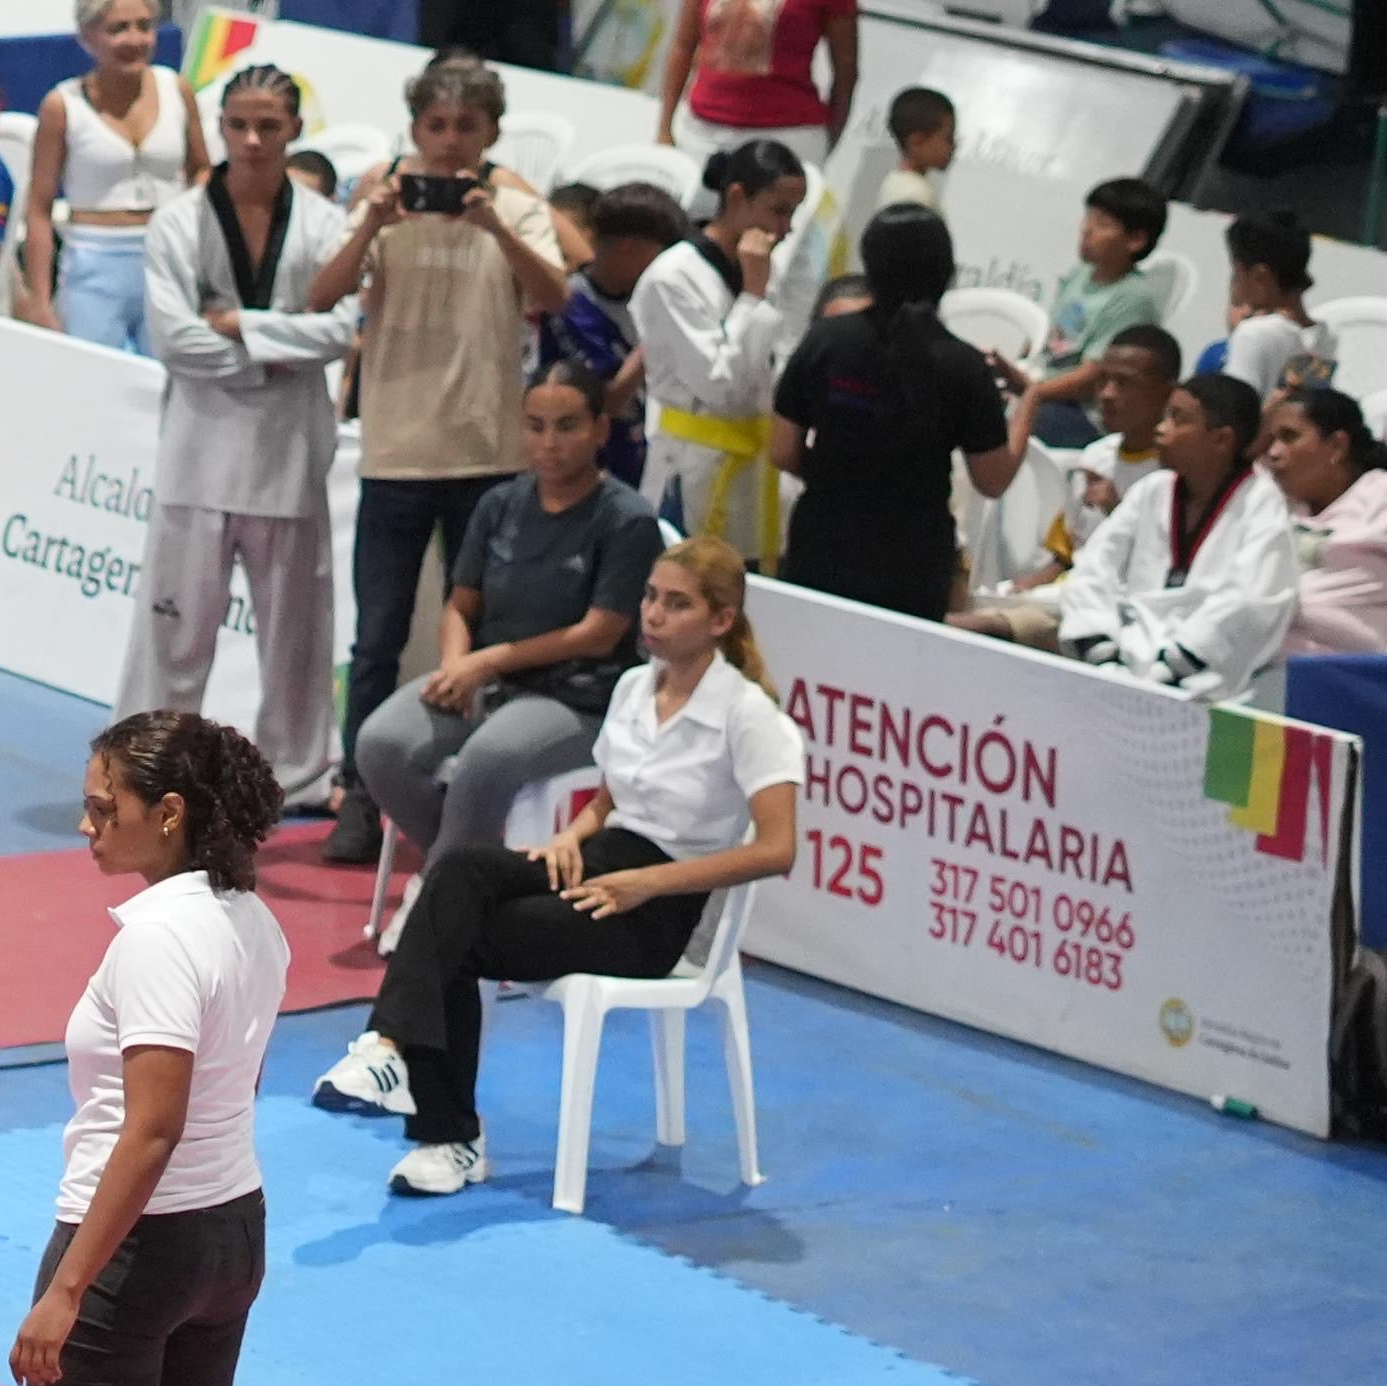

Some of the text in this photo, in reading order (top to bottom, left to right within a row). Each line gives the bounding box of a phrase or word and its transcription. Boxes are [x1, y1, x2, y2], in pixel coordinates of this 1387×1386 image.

[53, 454, 154, 523] Alcal
[1, 512, 142, 598] Cartage
[786, 678, 1057, 808] ATENCIÓN
[805, 754, 1133, 893] HOSPITALARIA
[806, 829, 884, 906] 125
[928, 901, 1123, 990] 317 401 6183
[930, 858, 1135, 950] 317 501 0966
